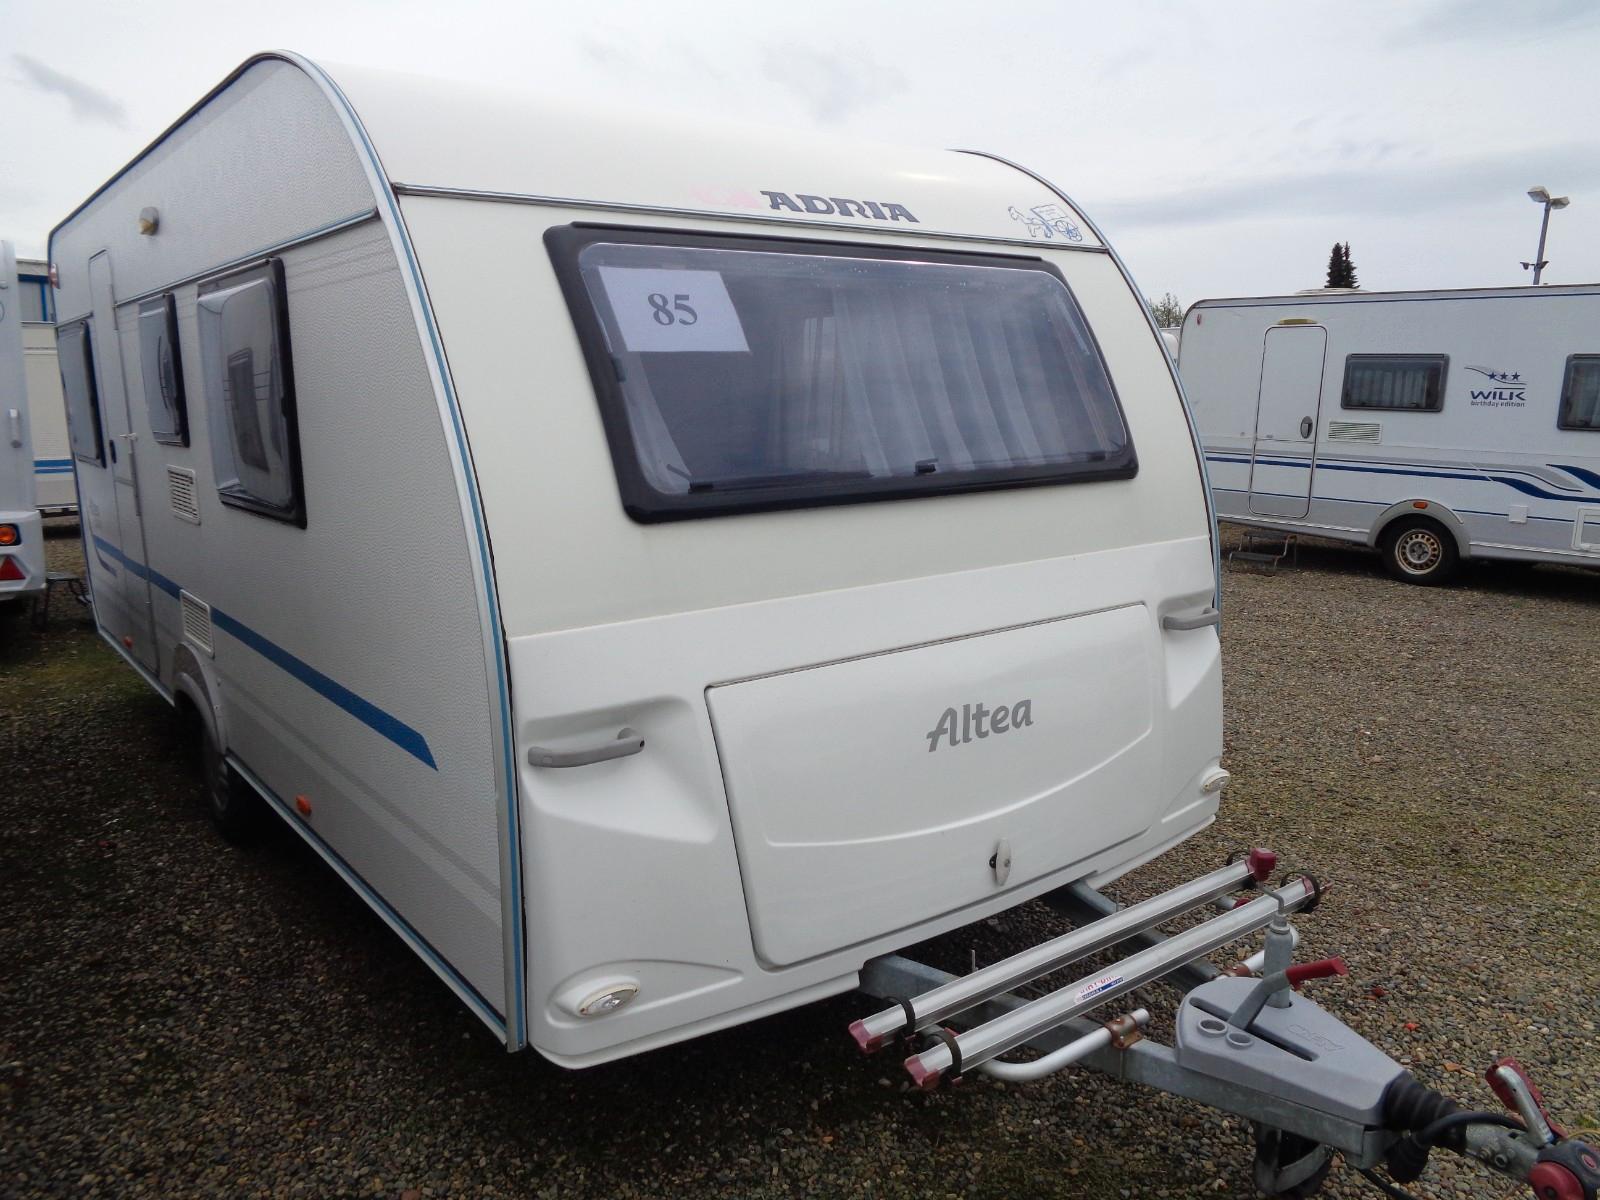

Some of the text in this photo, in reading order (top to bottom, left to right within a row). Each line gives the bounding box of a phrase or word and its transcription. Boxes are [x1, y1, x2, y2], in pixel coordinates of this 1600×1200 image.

[760, 190, 920, 223] ADRIA
[648, 293, 697, 325] 85
[1470, 390, 1526, 401] WILK
[1470, 400, 1499, 408] birthday
[926, 699, 1034, 752] Altea
